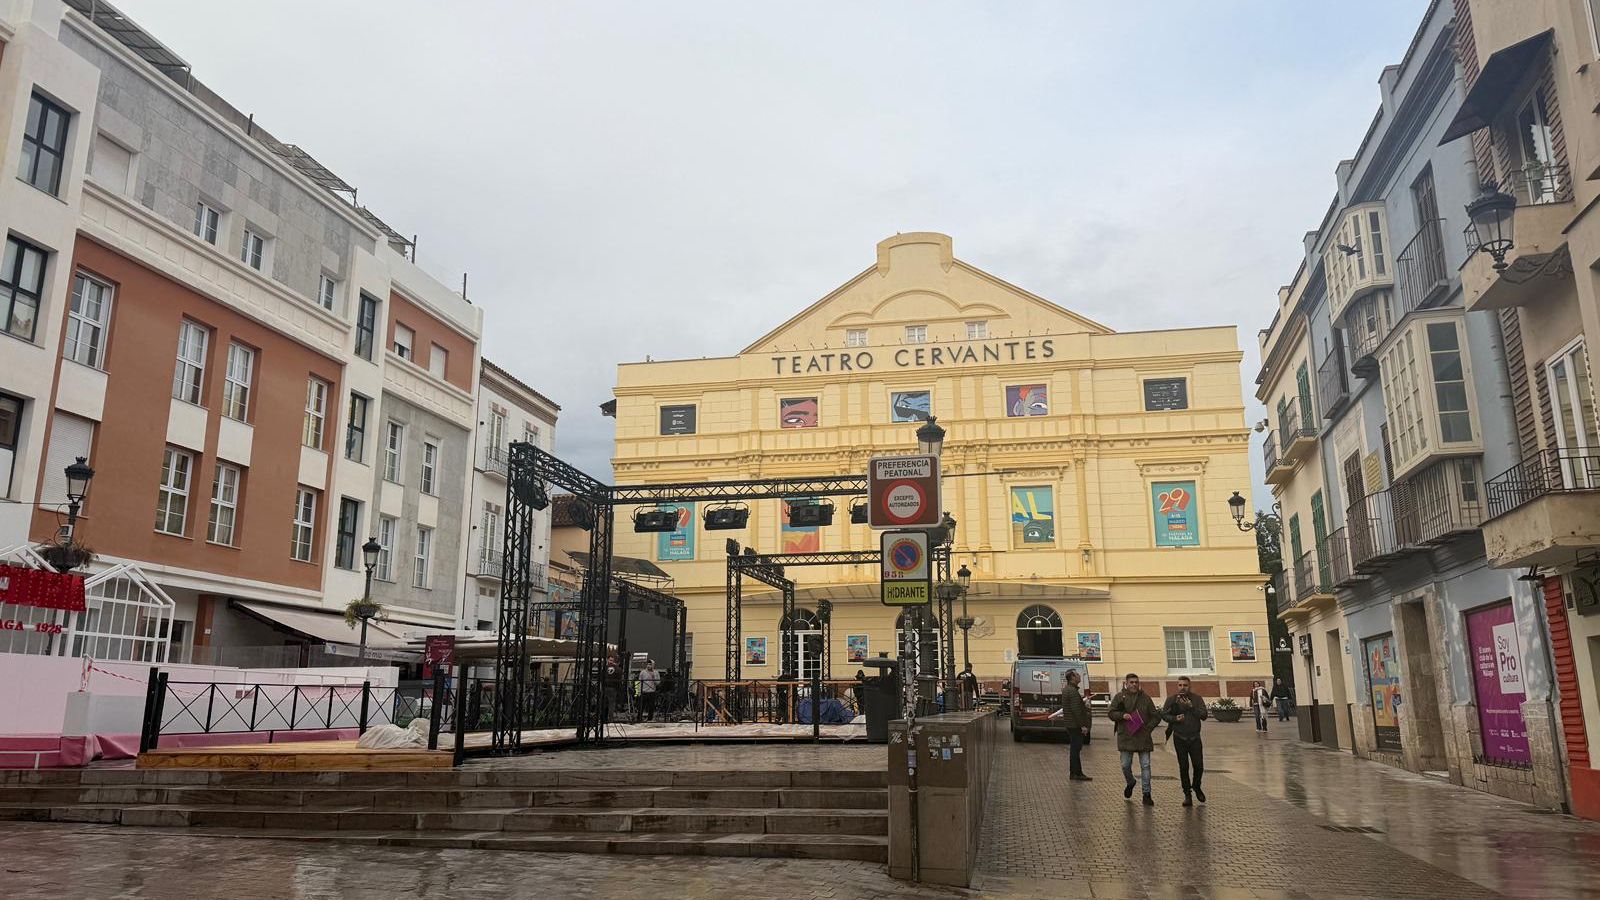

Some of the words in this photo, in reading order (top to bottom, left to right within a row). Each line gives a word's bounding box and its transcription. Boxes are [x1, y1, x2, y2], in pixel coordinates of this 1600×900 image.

[772, 352, 873, 374] TEATRO
[894, 340, 1054, 368] CERVANTES
[878, 459, 929, 469] PREFERENCIA
[884, 468, 923, 477] PEATONAL
[1157, 487, 1184, 512] 29
[887, 586, 925, 599] HIDRANTE
[35, 622, 63, 634] 1928
[1497, 635, 1510, 652] Soy
[1499, 652, 1517, 671] Pro
[1503, 673, 1519, 683] cultura
